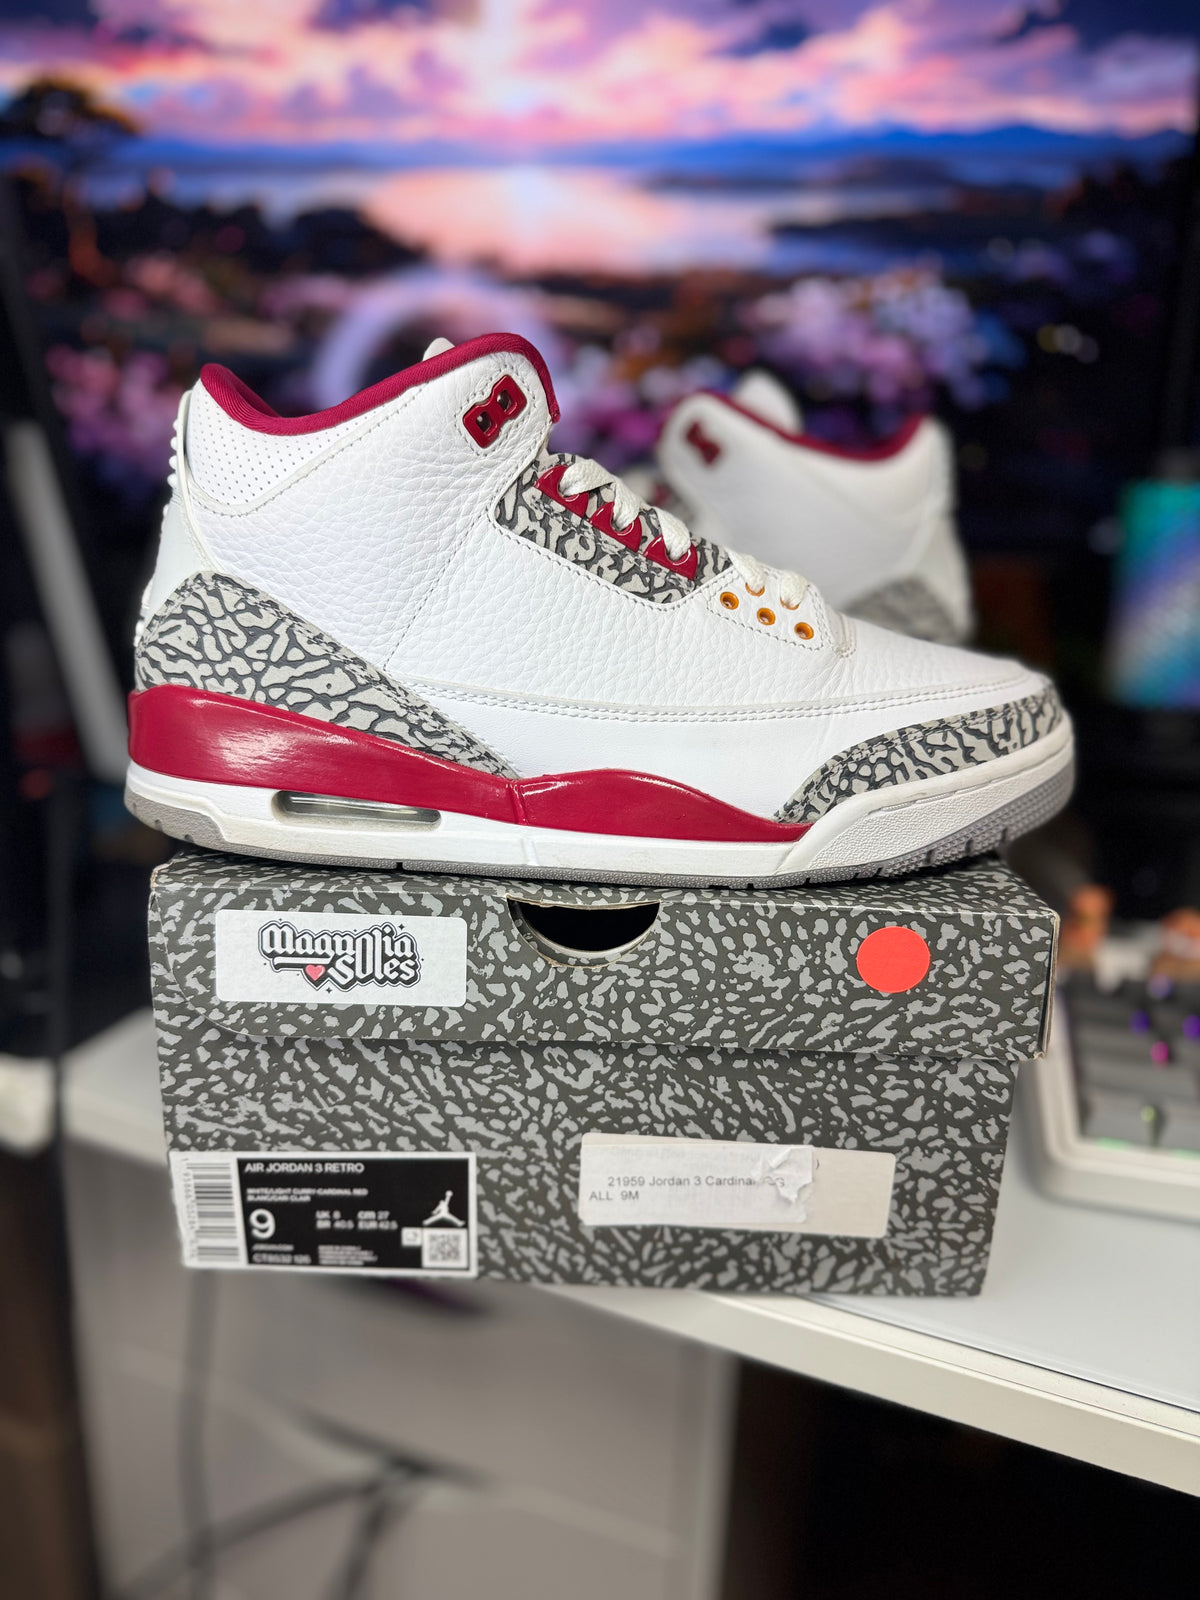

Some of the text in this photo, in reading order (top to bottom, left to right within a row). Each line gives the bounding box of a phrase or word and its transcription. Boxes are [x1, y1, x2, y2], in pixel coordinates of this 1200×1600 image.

[244, 1162, 366, 1174] AIR JORDAN 3 RETRO
[607, 1175, 646, 1187] 21959
[648, 1175, 691, 1187] Jordan
[693, 1175, 703, 1187] 3
[588, 1189, 640, 1202] ALL 9M
[249, 1208, 276, 1240] 9
[357, 1220, 378, 1231] EUR
